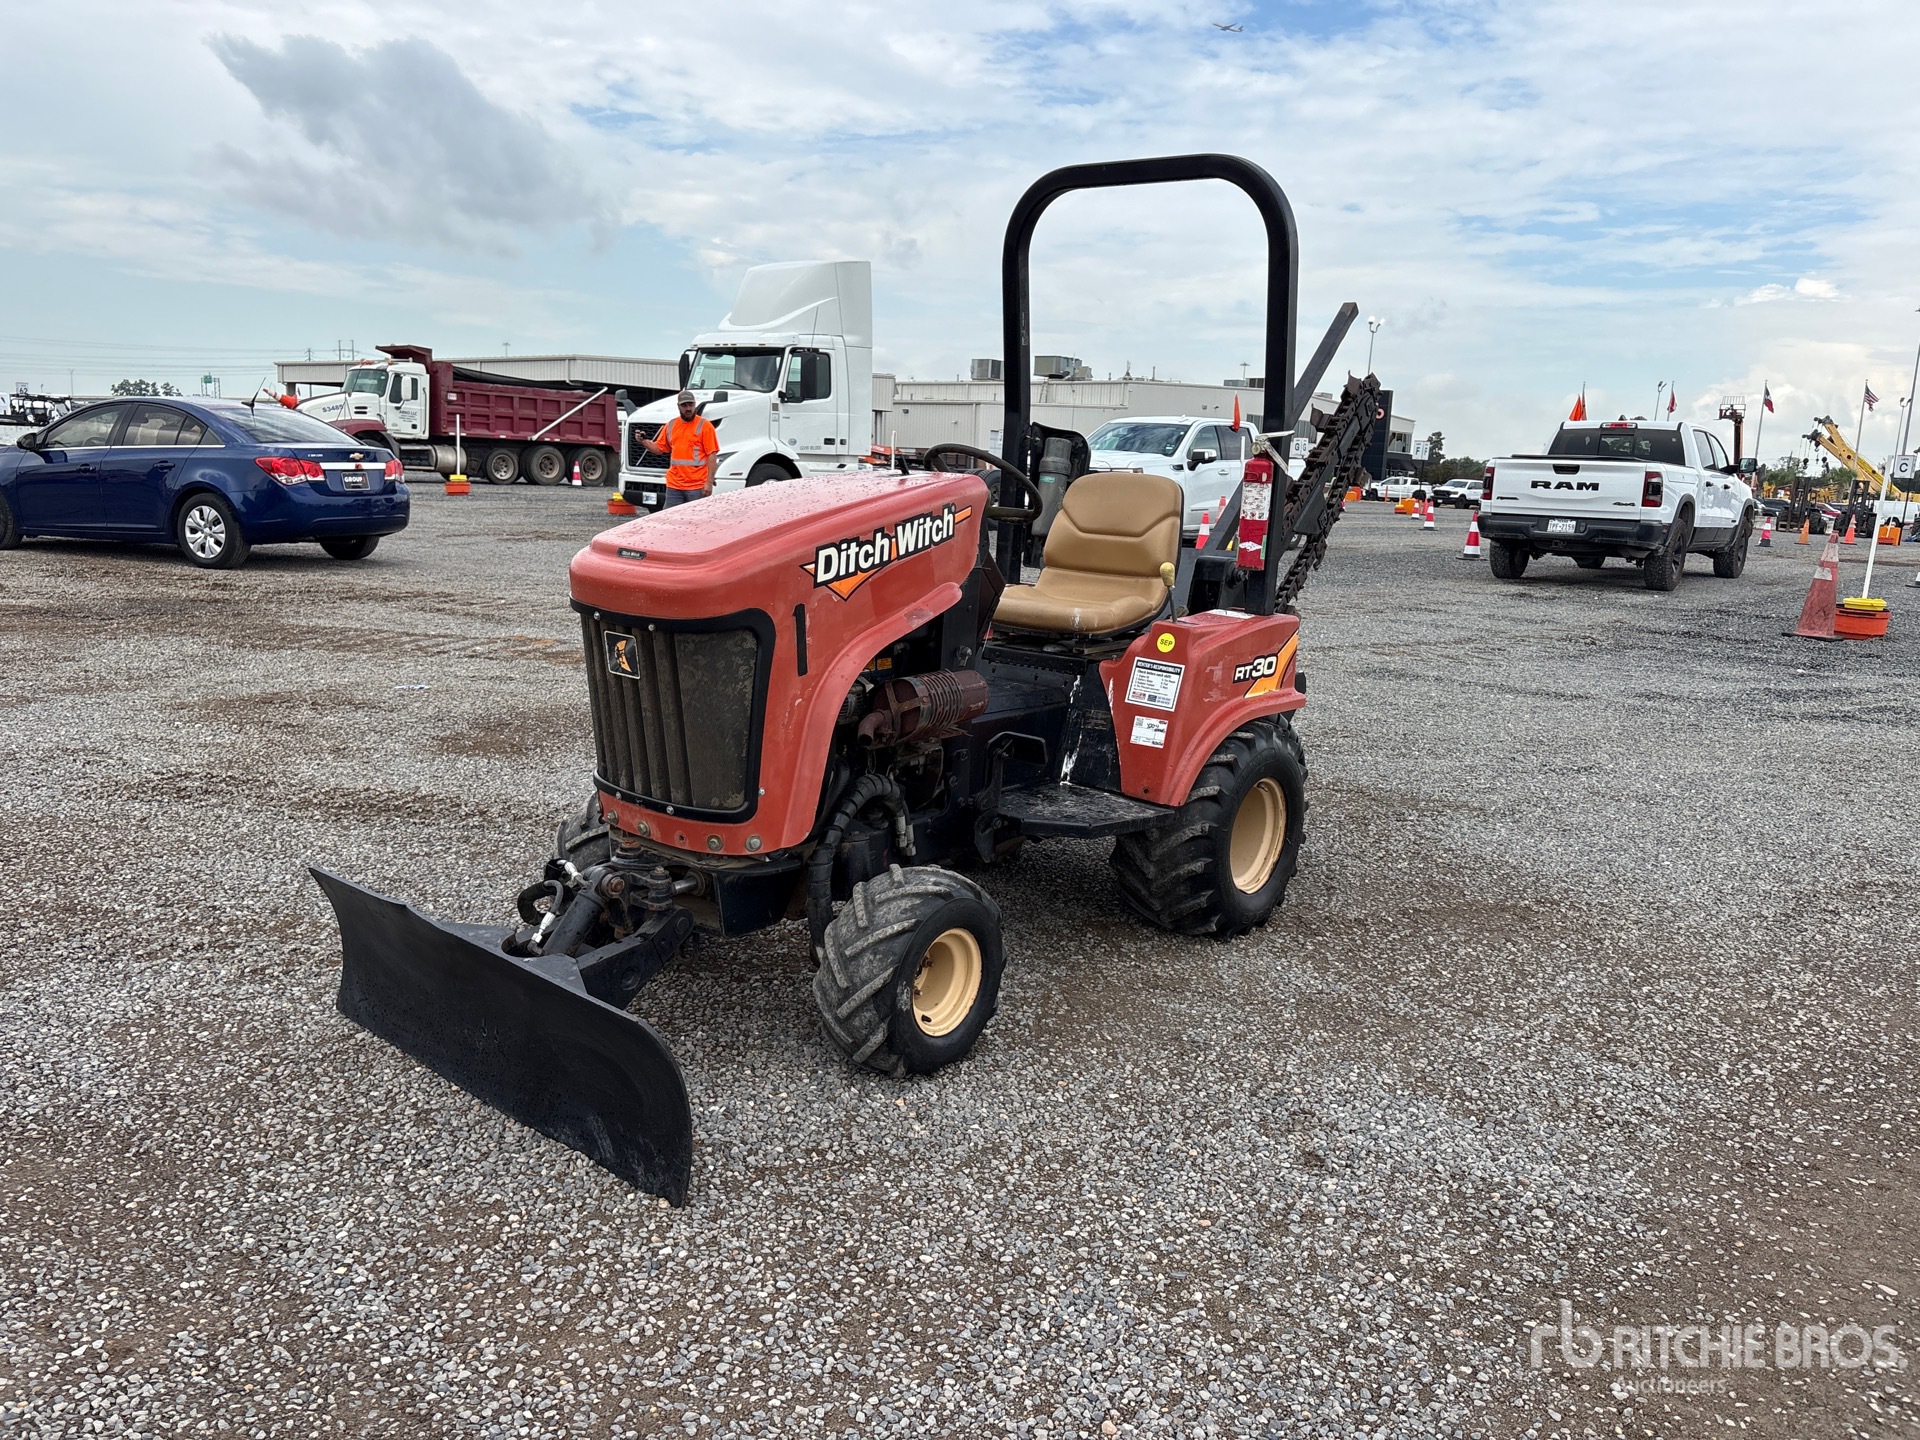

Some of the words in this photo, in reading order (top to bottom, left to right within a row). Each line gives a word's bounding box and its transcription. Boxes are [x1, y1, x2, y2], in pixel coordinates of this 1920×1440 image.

[1294, 442, 1300, 451] G
[1415, 446, 1420, 455] F
[1900, 462, 1908, 472] C
[1530, 480, 1600, 491] RAM
[816, 532, 890, 584] Ditch
[896, 508, 954, 556] Witch
[1234, 656, 1277, 680] RT30
